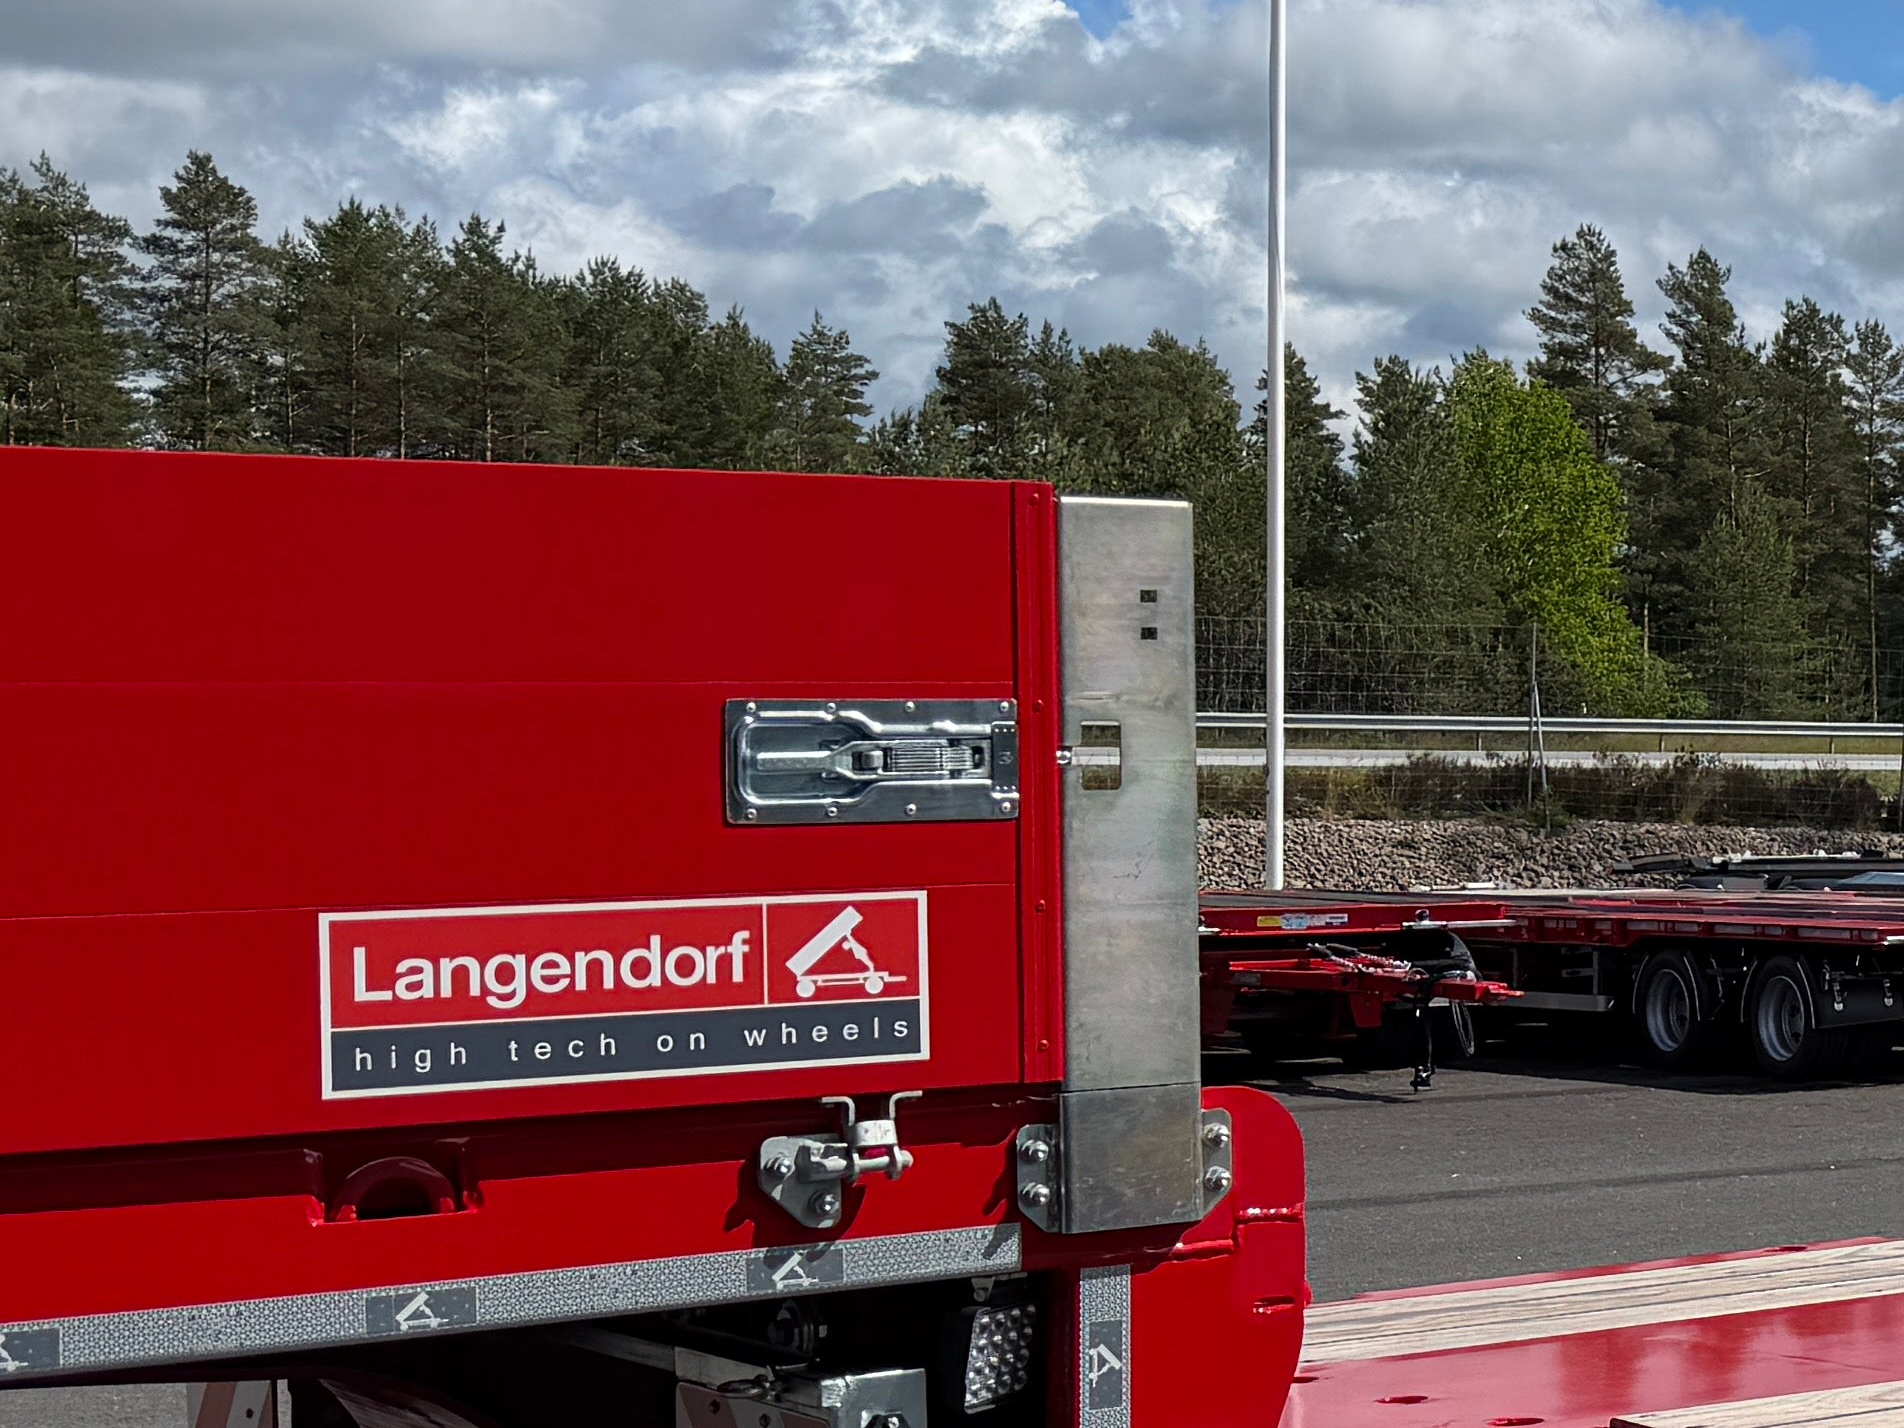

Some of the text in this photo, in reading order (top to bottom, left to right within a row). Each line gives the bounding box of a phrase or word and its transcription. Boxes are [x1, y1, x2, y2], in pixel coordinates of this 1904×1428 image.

[353, 930, 750, 1009] Langendorf
[355, 1016, 909, 1073] high tech on wheels
